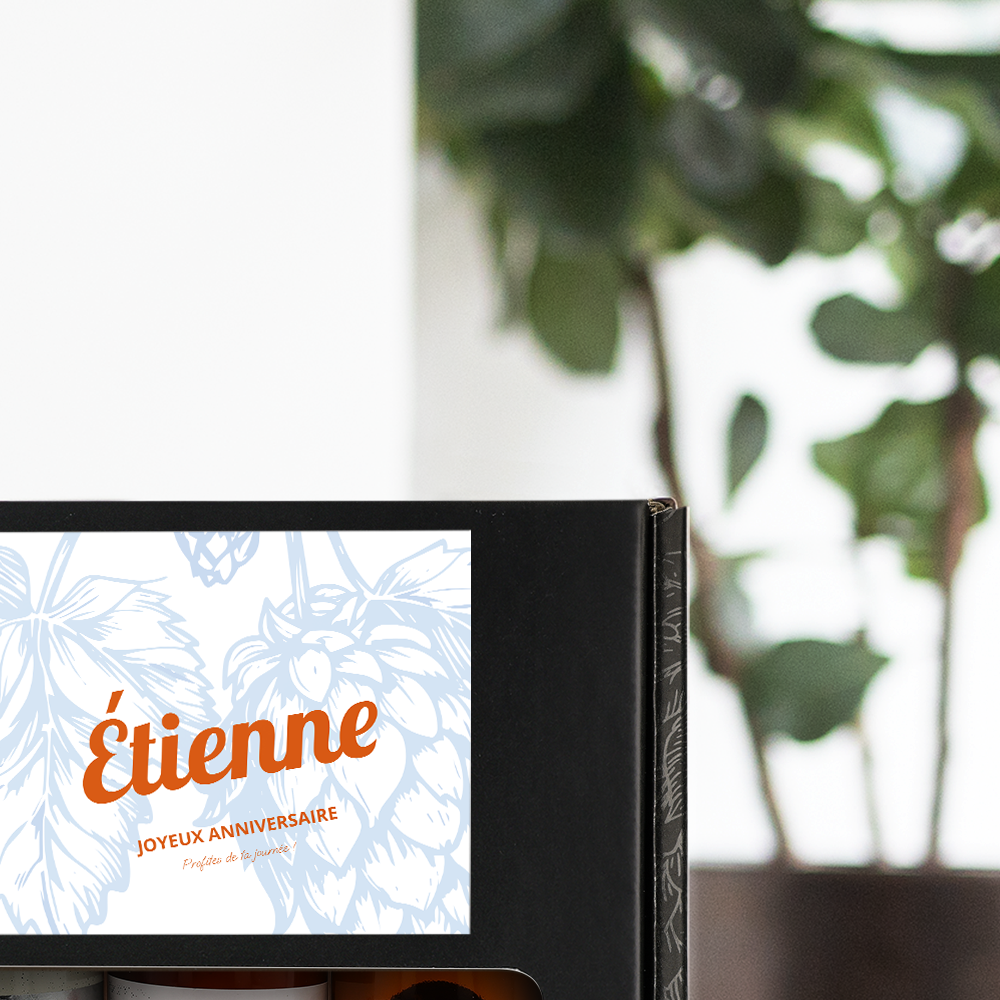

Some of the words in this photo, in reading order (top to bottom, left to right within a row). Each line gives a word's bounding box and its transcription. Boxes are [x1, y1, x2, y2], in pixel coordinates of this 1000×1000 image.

[82, 689, 378, 805] Étienne
[137, 828, 205, 858] JOYEUX
[208, 806, 338, 842] ANNIVERSAIRE
[225, 851, 239, 863] de
[240, 849, 252, 860] ta
[251, 843, 290, 863] journée
